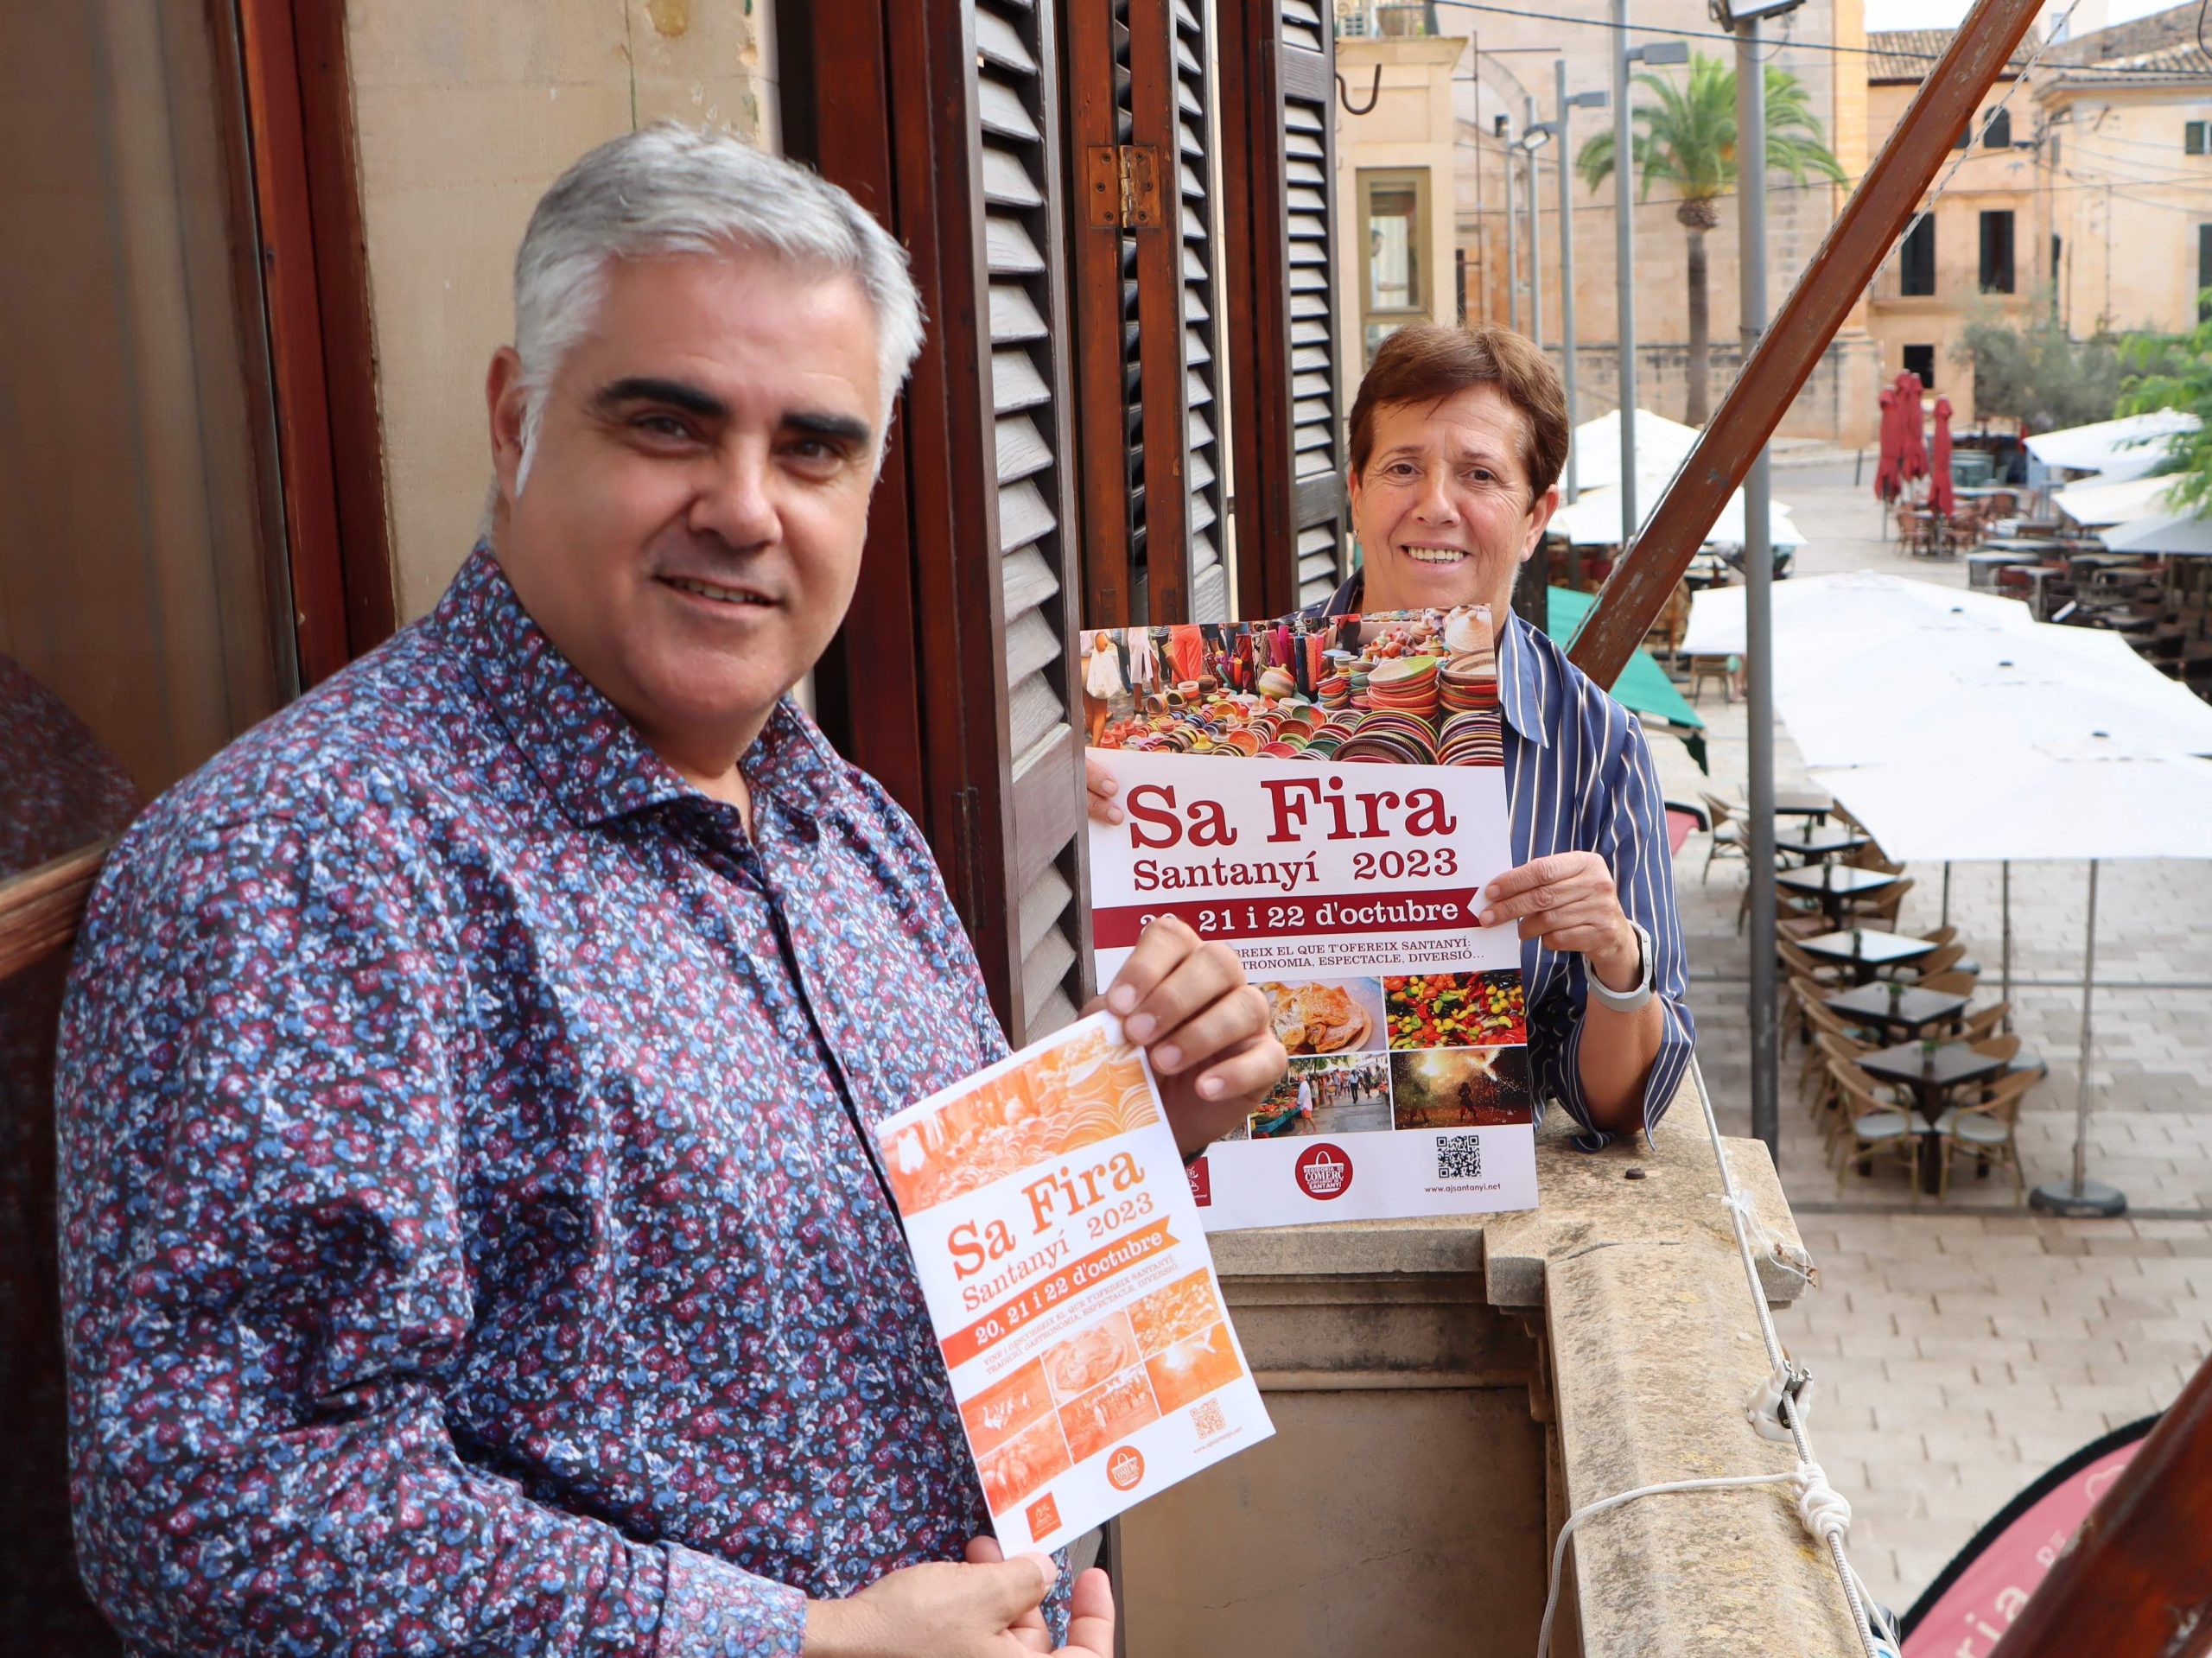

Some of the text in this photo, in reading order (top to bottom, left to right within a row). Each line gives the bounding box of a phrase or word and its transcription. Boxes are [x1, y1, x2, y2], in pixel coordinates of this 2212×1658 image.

[1127, 776, 1457, 848] Sa Fira
[1134, 848, 1458, 892] Santanyí 2023
[1198, 910, 1236, 932] 21
[1247, 906, 1258, 929] i
[1268, 905, 1305, 928] 22
[1315, 899, 1459, 926] d'octubre
[1241, 958, 1314, 970] TRONOMIA,
[1319, 954, 1404, 967] ESPECTACLE,
[1277, 946, 1293, 956] EL
[1298, 944, 1325, 956] QUE
[1328, 941, 1398, 954] T'OFEREIX
[1425, 1183, 1501, 1193] www.ajsantanyi.net
[948, 1152, 1145, 1281] Sa Fira
[963, 1191, 1154, 1312] Santanyí 2023
[976, 1231, 1163, 1346] 20, 21 i 22 d'octubre
